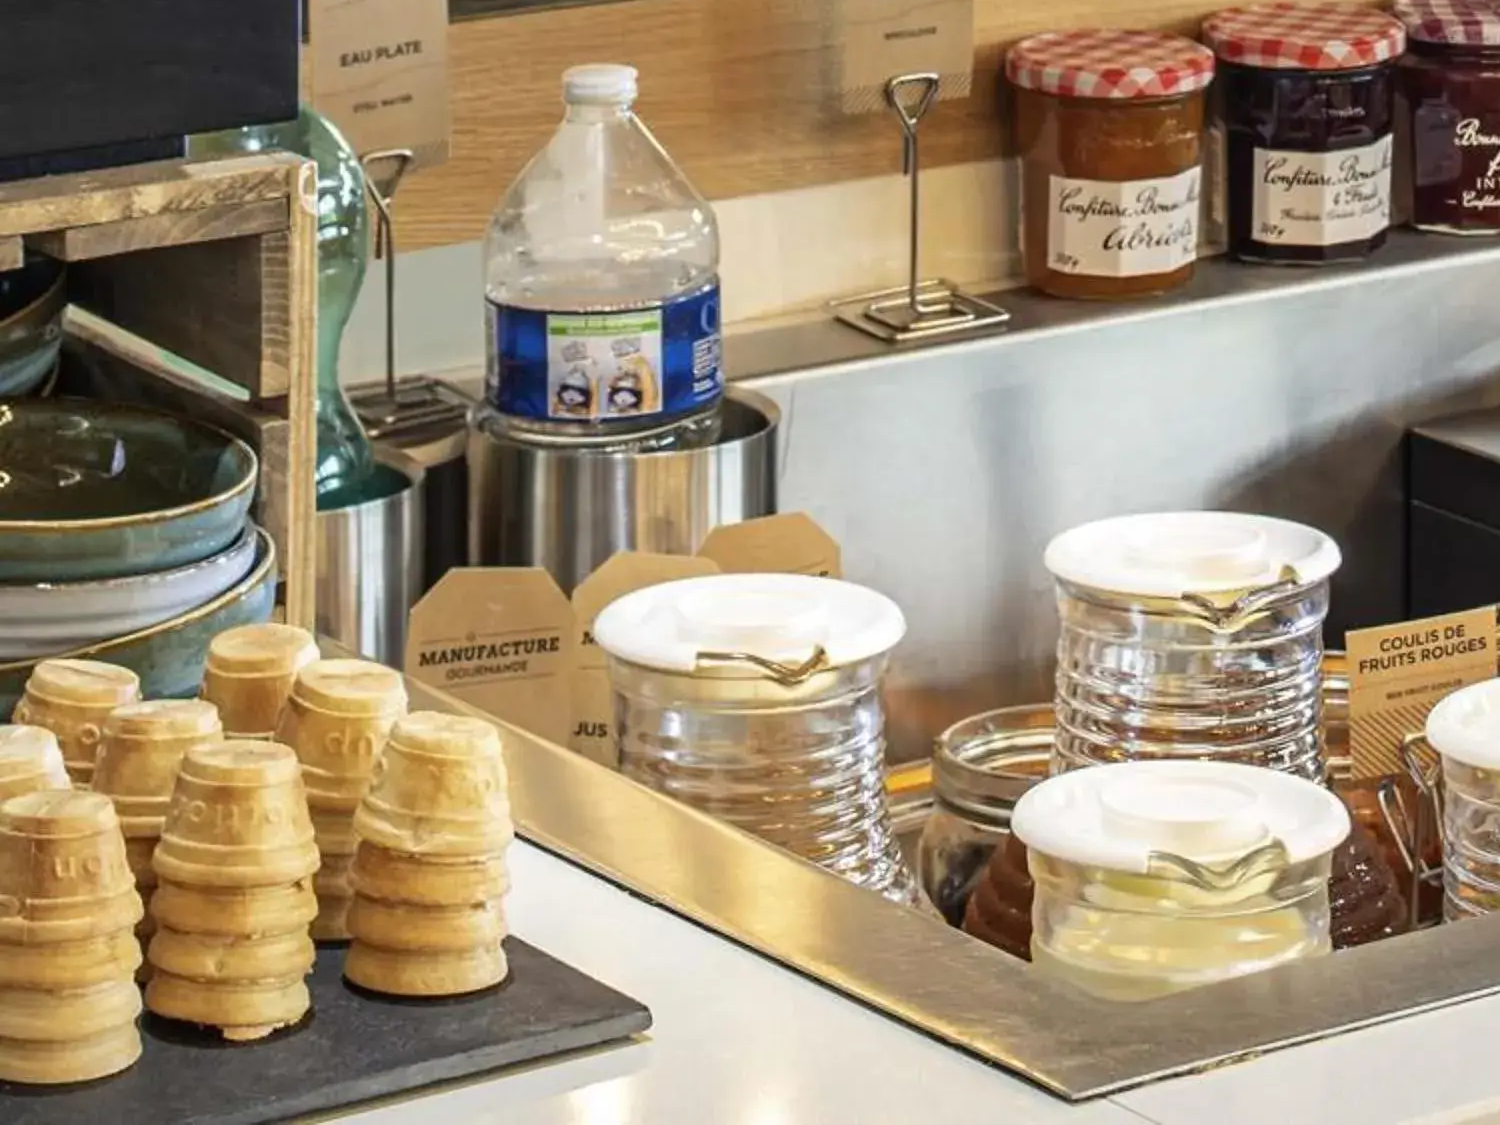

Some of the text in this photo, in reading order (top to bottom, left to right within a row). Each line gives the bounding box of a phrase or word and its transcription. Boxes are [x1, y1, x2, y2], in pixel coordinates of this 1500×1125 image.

[339, 40, 422, 68] EAU PLATE
[1263, 157, 1332, 192] Confiture
[1058, 186, 1128, 223] Confiture
[419, 637, 560, 667] MANUFACTURE
[1379, 624, 1466, 653] COULIS DE
[1359, 636, 1487, 674] FRUITS ROUGES
[445, 659, 529, 682] GOURMANDE
[572, 721, 608, 738] JUS
